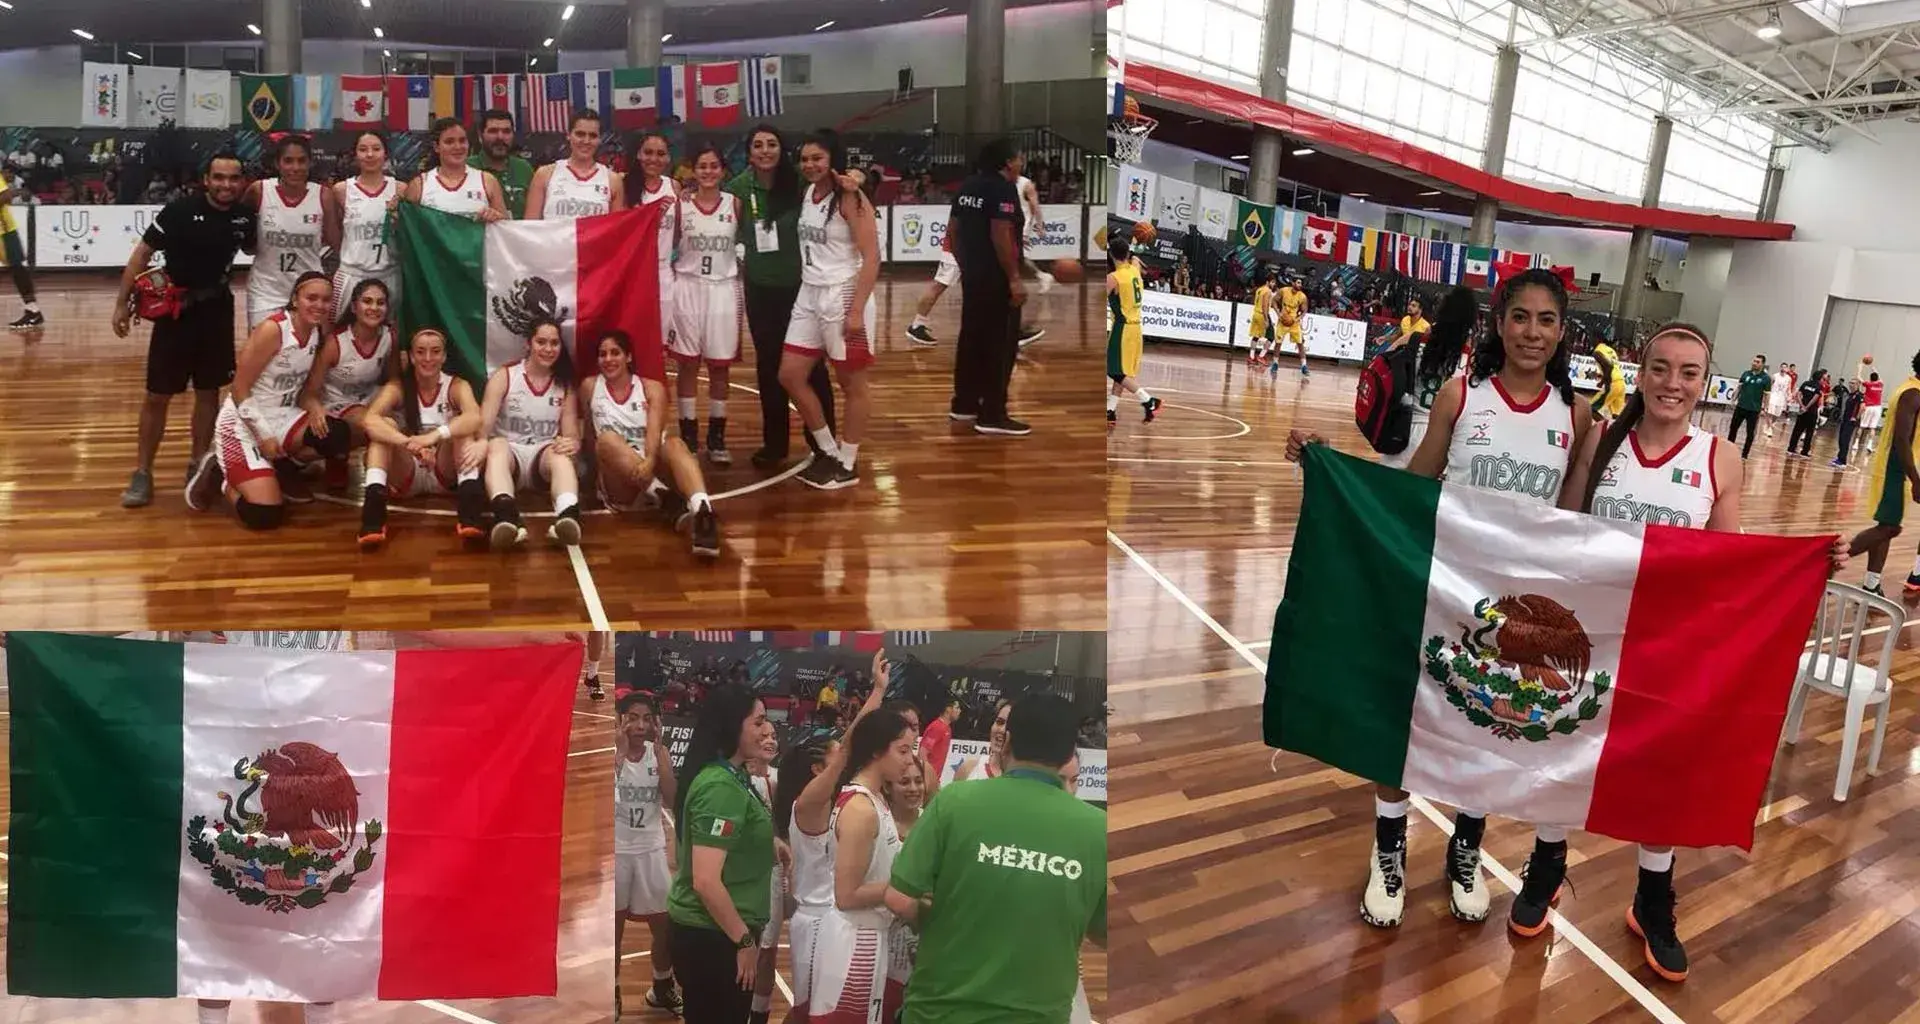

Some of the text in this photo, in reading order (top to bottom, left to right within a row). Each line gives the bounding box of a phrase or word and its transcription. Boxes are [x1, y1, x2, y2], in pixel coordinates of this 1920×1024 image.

[958, 195, 984, 209] CHILE
[63, 254, 89, 264] FISU
[280, 252, 297, 273] 12
[372, 243, 383, 264] 7
[701, 255, 712, 275] 9
[1142, 304, 1220, 323] eração Brasileira
[1142, 315, 1226, 333] porto Universitário
[1470, 452, 1561, 500] MÉXICO
[952, 744, 978, 755] FISU
[630, 807, 646, 828] 12
[977, 842, 1083, 880] MÉXICO
[873, 998, 882, 1022] 7
